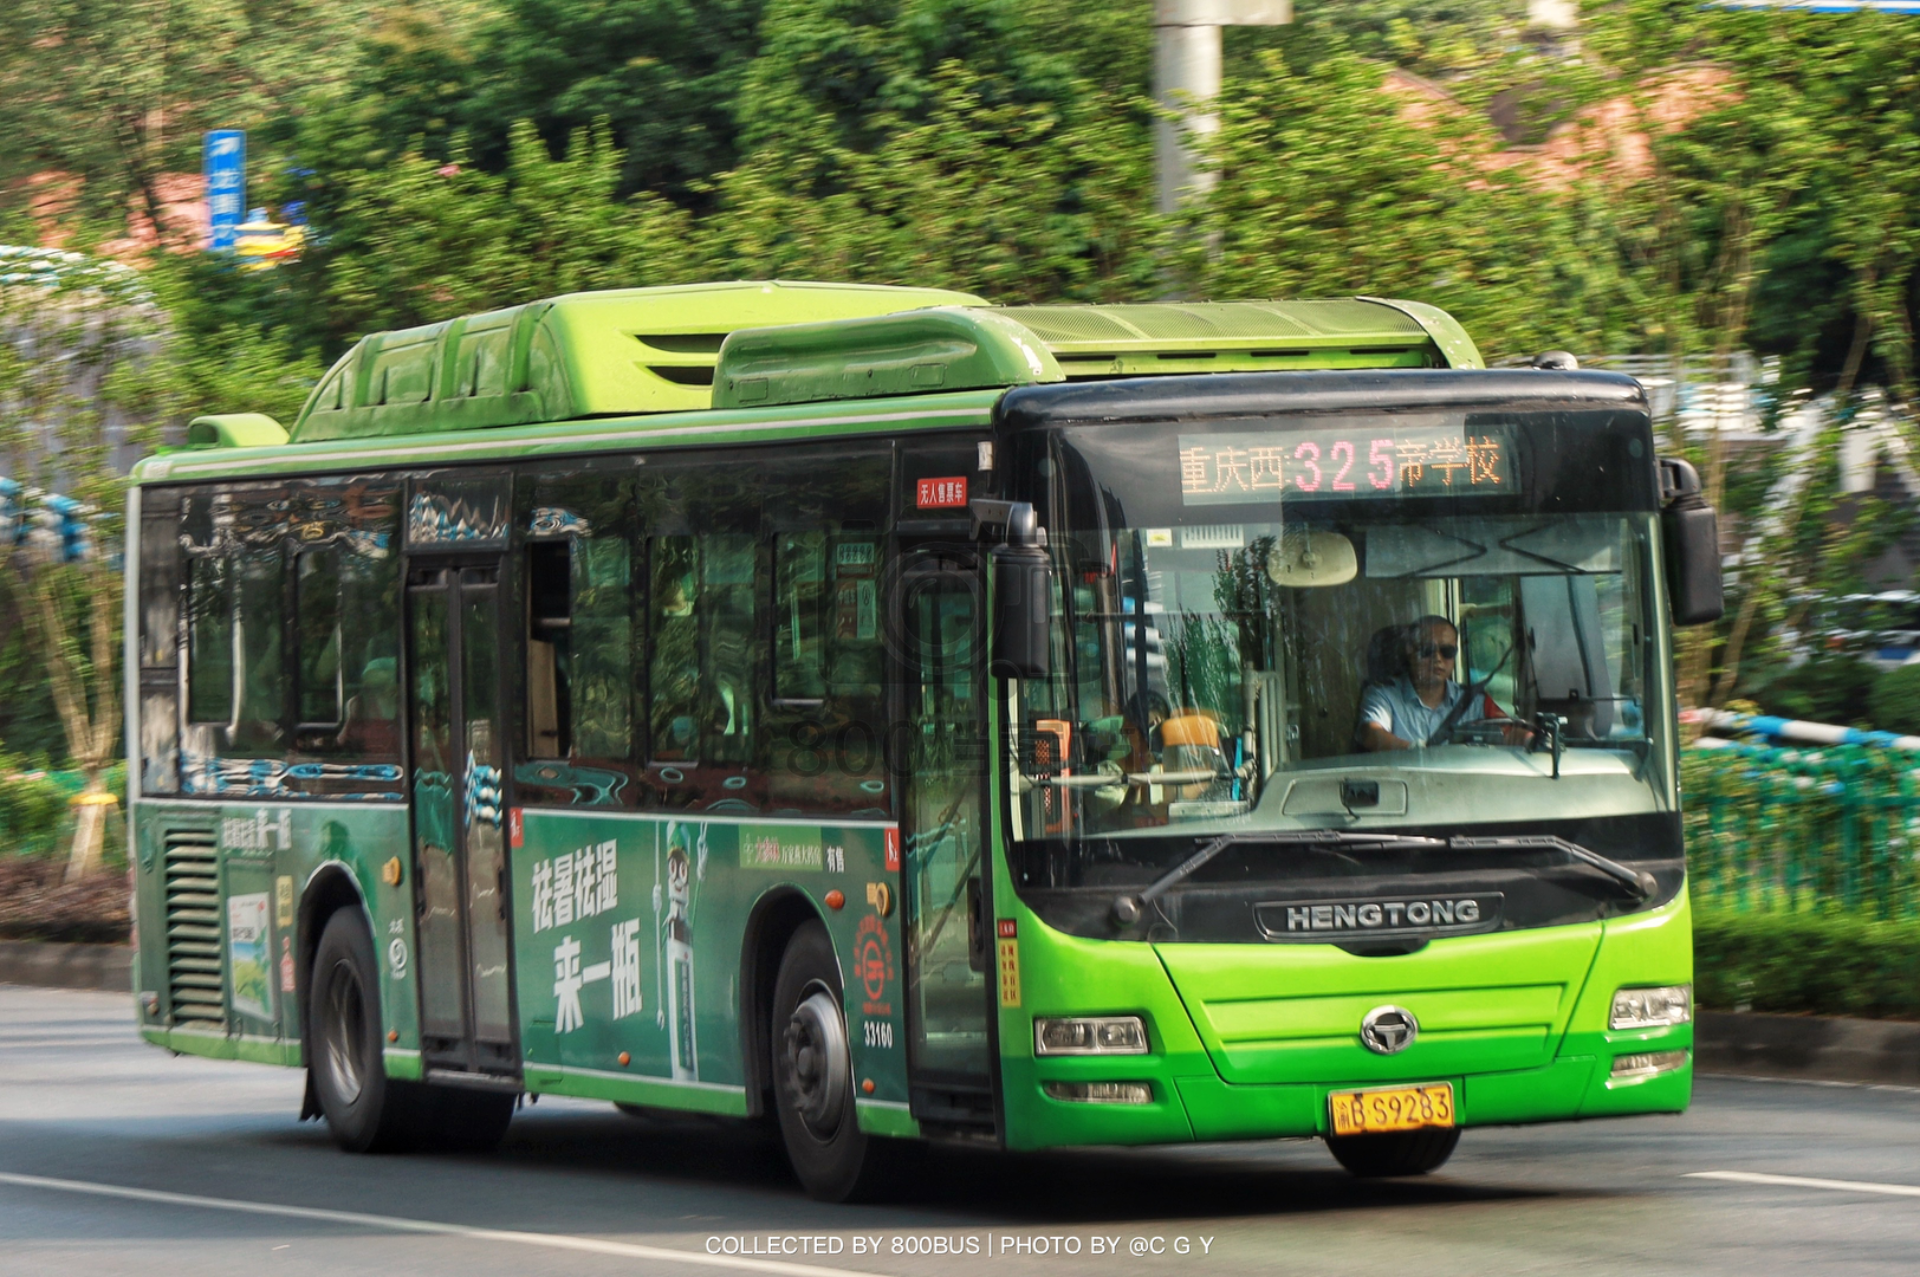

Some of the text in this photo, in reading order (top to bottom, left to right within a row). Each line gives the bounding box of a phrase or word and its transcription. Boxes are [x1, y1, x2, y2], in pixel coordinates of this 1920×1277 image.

[920, 481, 963, 505] 无人售票车
[826, 844, 845, 873] 有售
[531, 838, 618, 934] 祛暑祛湿
[1287, 899, 1480, 932] HENGTONG
[552, 918, 643, 1035] 来一瓶
[863, 1019, 894, 1050] 33160
